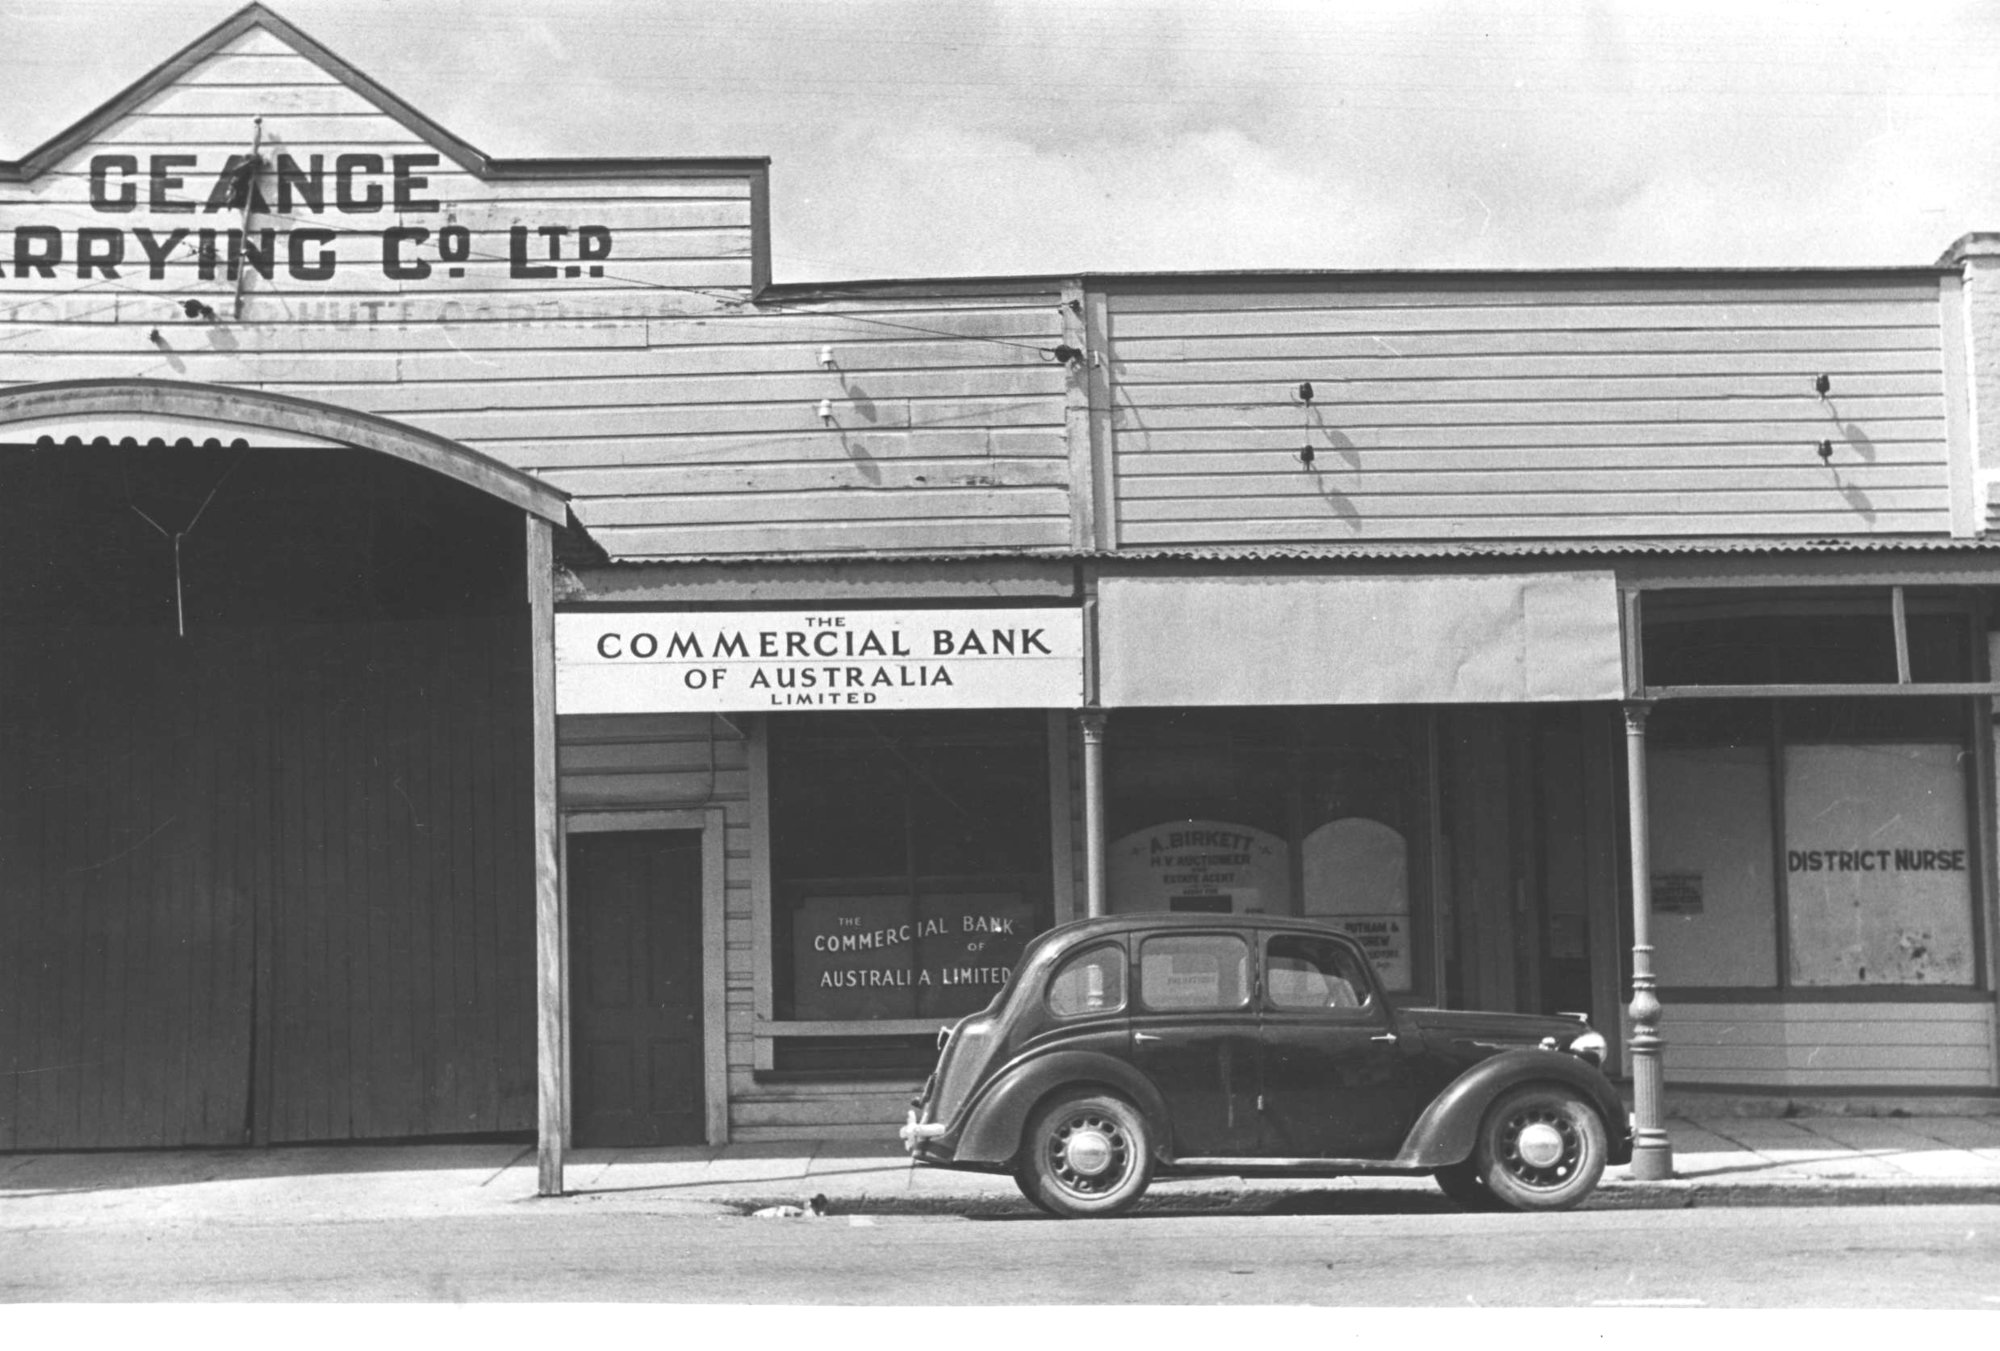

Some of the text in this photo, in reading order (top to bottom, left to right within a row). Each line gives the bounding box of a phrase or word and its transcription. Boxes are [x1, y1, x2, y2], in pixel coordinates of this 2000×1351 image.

[90, 153, 440, 214] GEANGE
[0, 226, 336, 281] RRYING
[805, 616, 846, 627] THE
[597, 628, 1052, 659] COMMERCIAL BANK
[684, 665, 954, 690] OF AUSTRALIA
[771, 692, 878, 706] LIMITED
[1169, 830, 1255, 851] BIRKETT
[1788, 849, 1966, 872] DISTRICT NURSE
[838, 917, 861, 926] THE
[962, 915, 1014, 935] BANK
[967, 942, 985, 952] OF
[942, 967, 1011, 985] LIMITED
